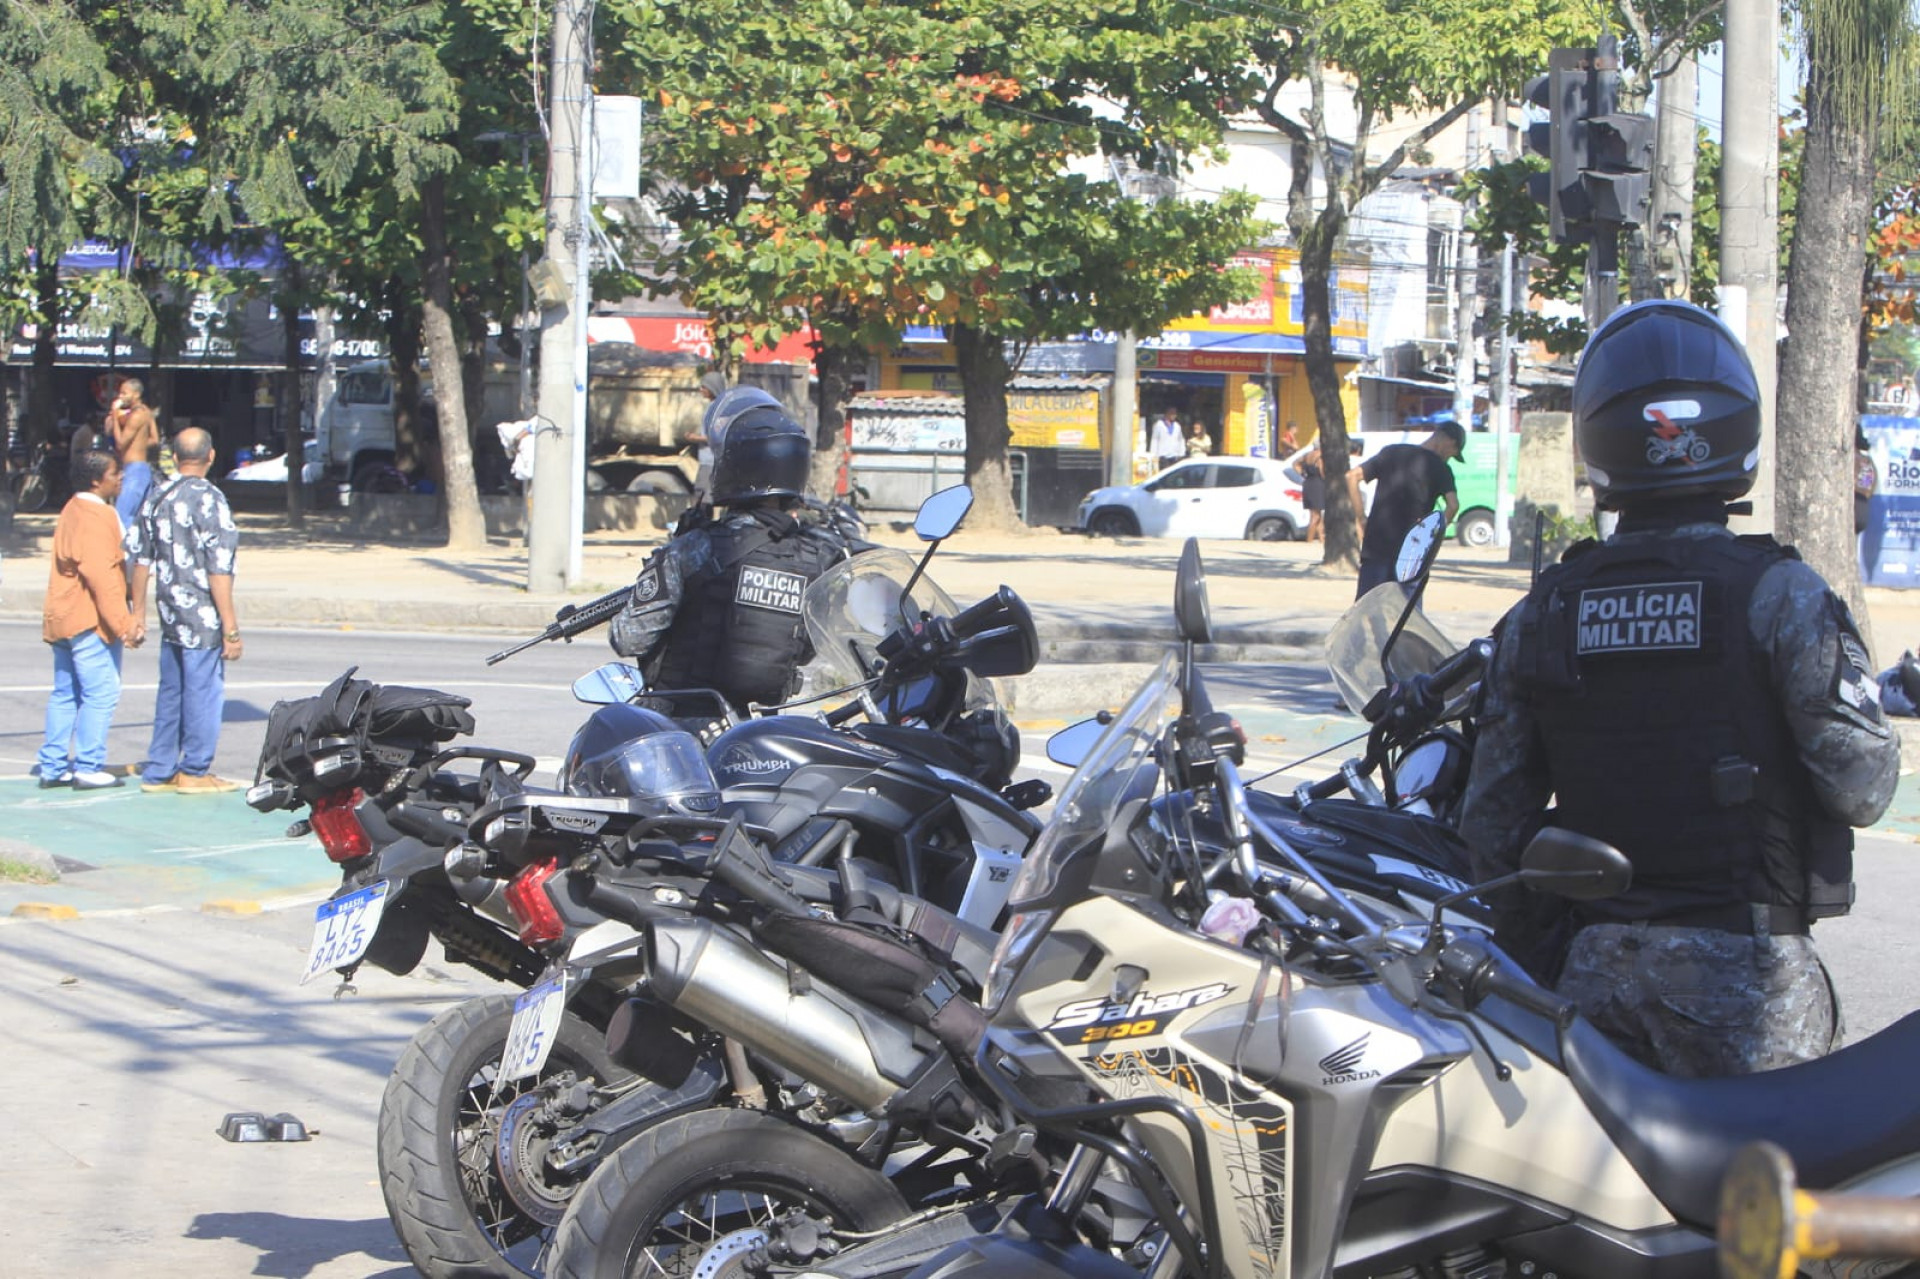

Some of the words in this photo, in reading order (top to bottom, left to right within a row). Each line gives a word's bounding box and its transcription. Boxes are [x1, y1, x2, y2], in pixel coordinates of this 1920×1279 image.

[1889, 460, 1920, 479] Rio
[743, 570, 800, 594] POLÍCIA
[740, 586, 800, 610] MILITAR
[1581, 589, 1696, 622] POLÍCIA
[1580, 619, 1696, 649] MILITAR
[724, 760, 790, 774] TRIUMPH
[550, 814, 596, 828] TRIUMPH
[1044, 982, 1236, 1030] Sahara
[1081, 1020, 1158, 1043] 300
[1322, 1069, 1382, 1086] HONDA
